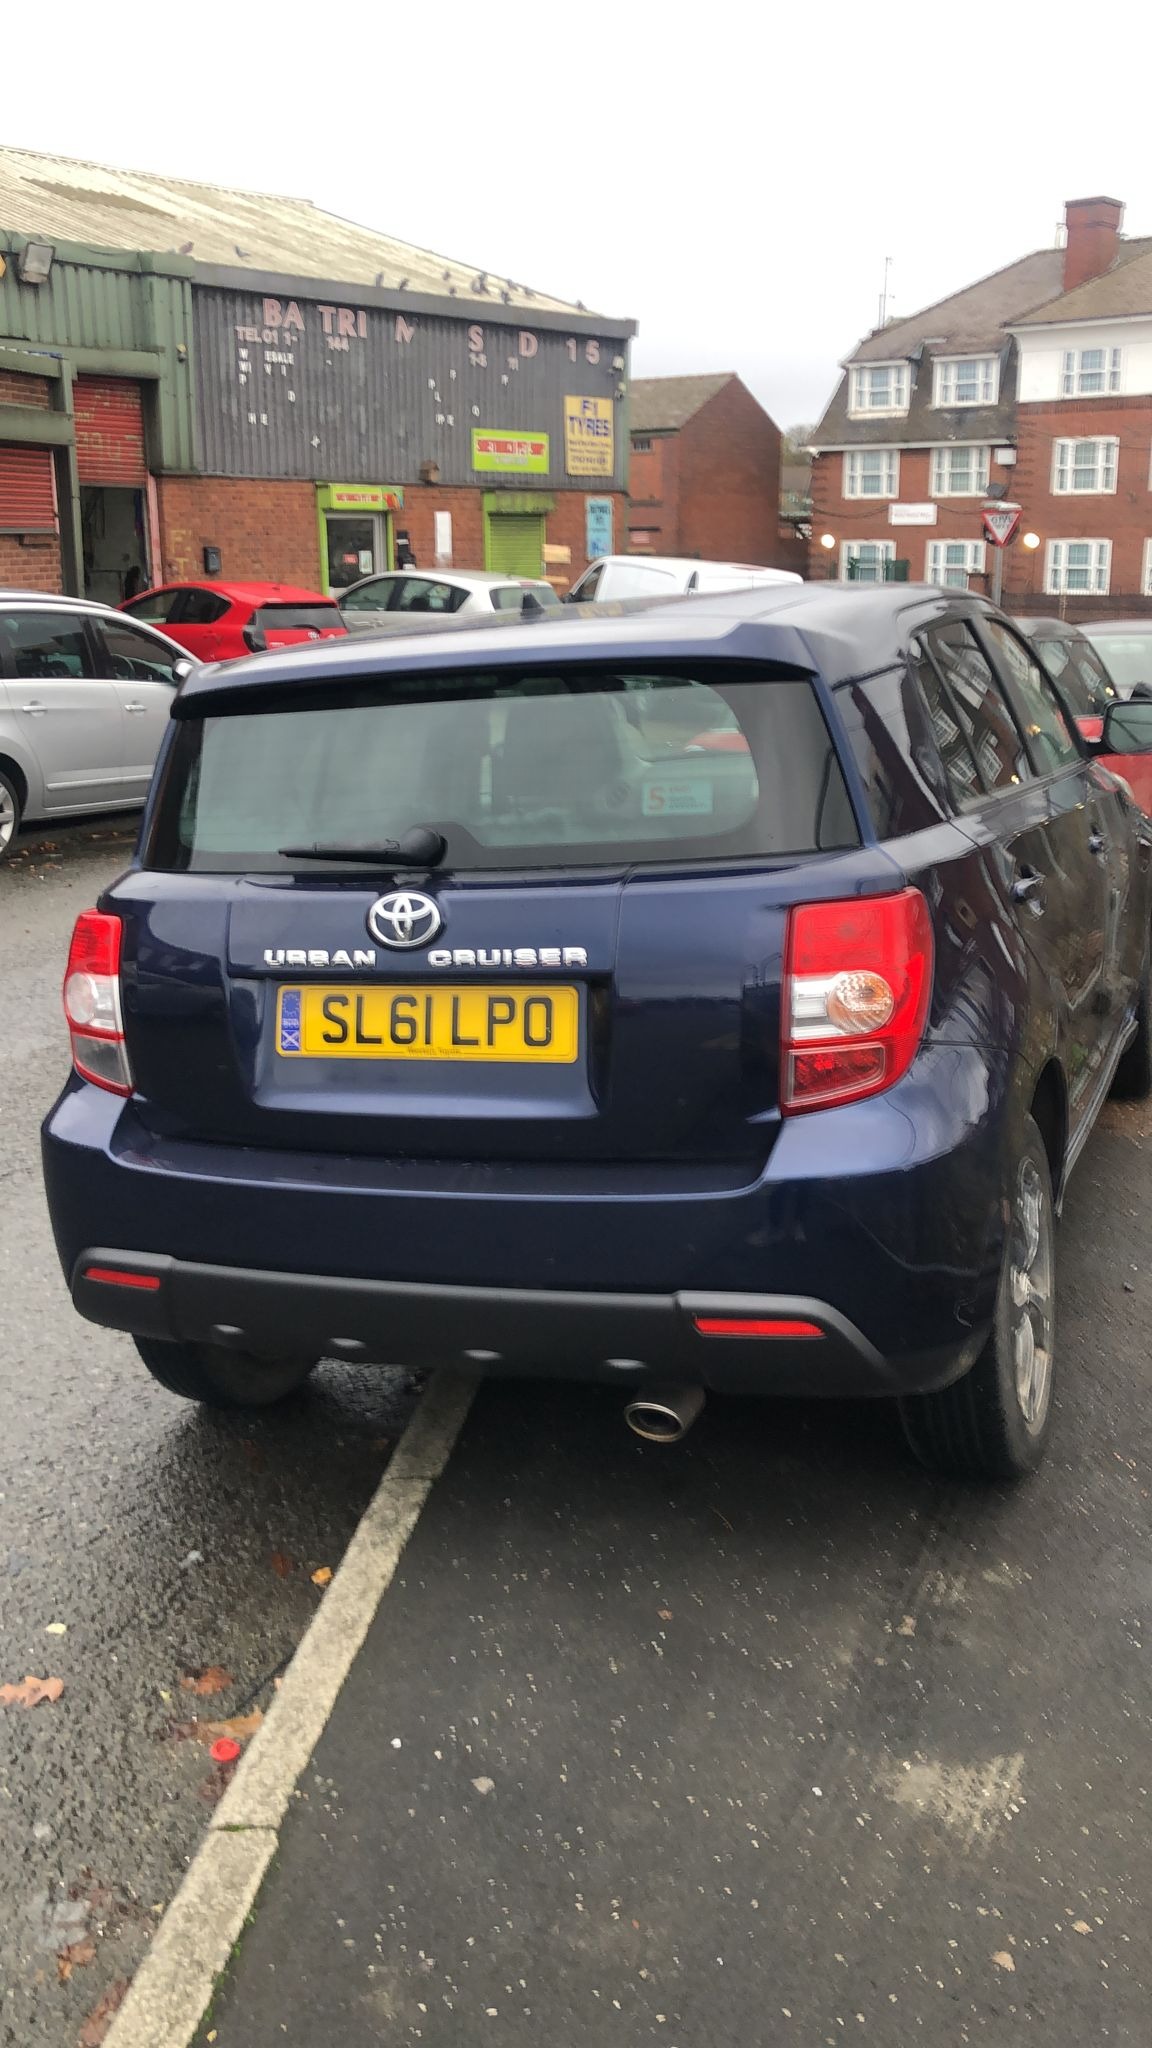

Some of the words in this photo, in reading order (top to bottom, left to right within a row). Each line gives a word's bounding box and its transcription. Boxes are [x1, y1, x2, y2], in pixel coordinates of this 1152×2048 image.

[569, 416, 609, 437] TYRES
[263, 949, 376, 969] URBAN
[427, 946, 588, 968] CRUISER
